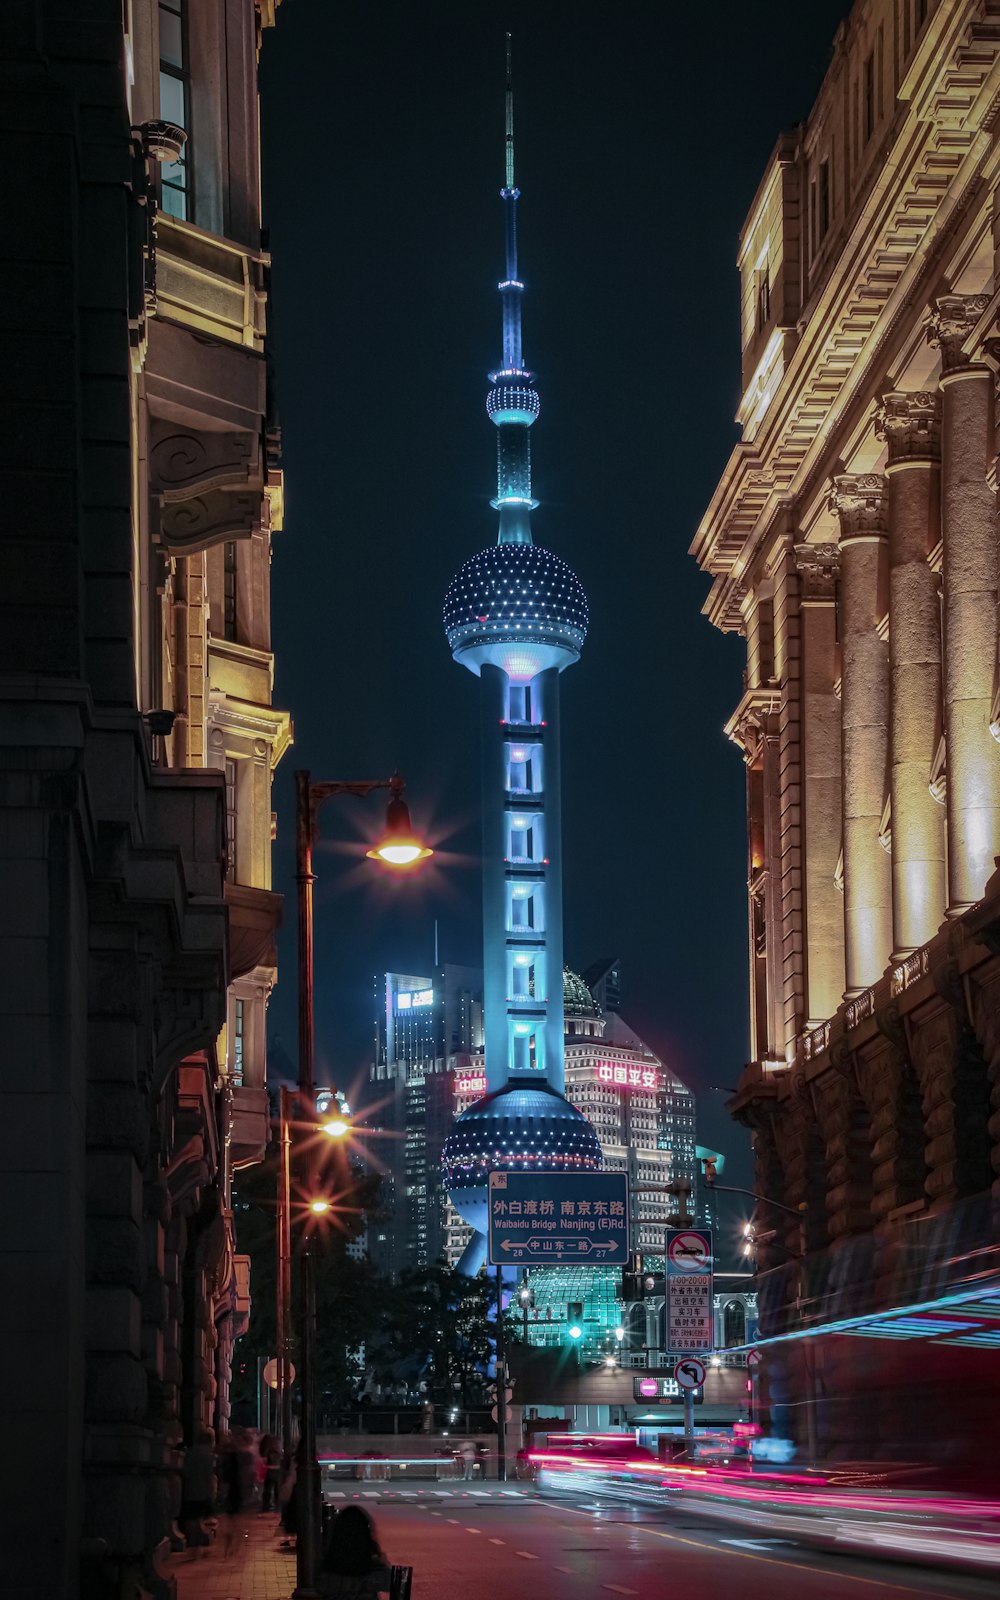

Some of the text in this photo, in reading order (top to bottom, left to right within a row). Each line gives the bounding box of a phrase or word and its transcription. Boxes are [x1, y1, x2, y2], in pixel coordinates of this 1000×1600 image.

[599, 1065, 656, 1088] 中国平安
[497, 1175, 507, 1183] 东
[493, 1200, 625, 1215] 外白渡桥 南京东路
[495, 1219, 529, 1229] Waibaidu
[531, 1219, 557, 1231] Bridge
[560, 1218, 596, 1231] Nanjing
[530, 1240, 589, 1251] 中山东一路
[512, 1249, 523, 1257] 28
[596, 1249, 606, 1257] 27
[671, 1286, 708, 1295] 外省市号牌
[674, 1297, 705, 1306] 出租空车
[678, 1307, 701, 1316] 实习车
